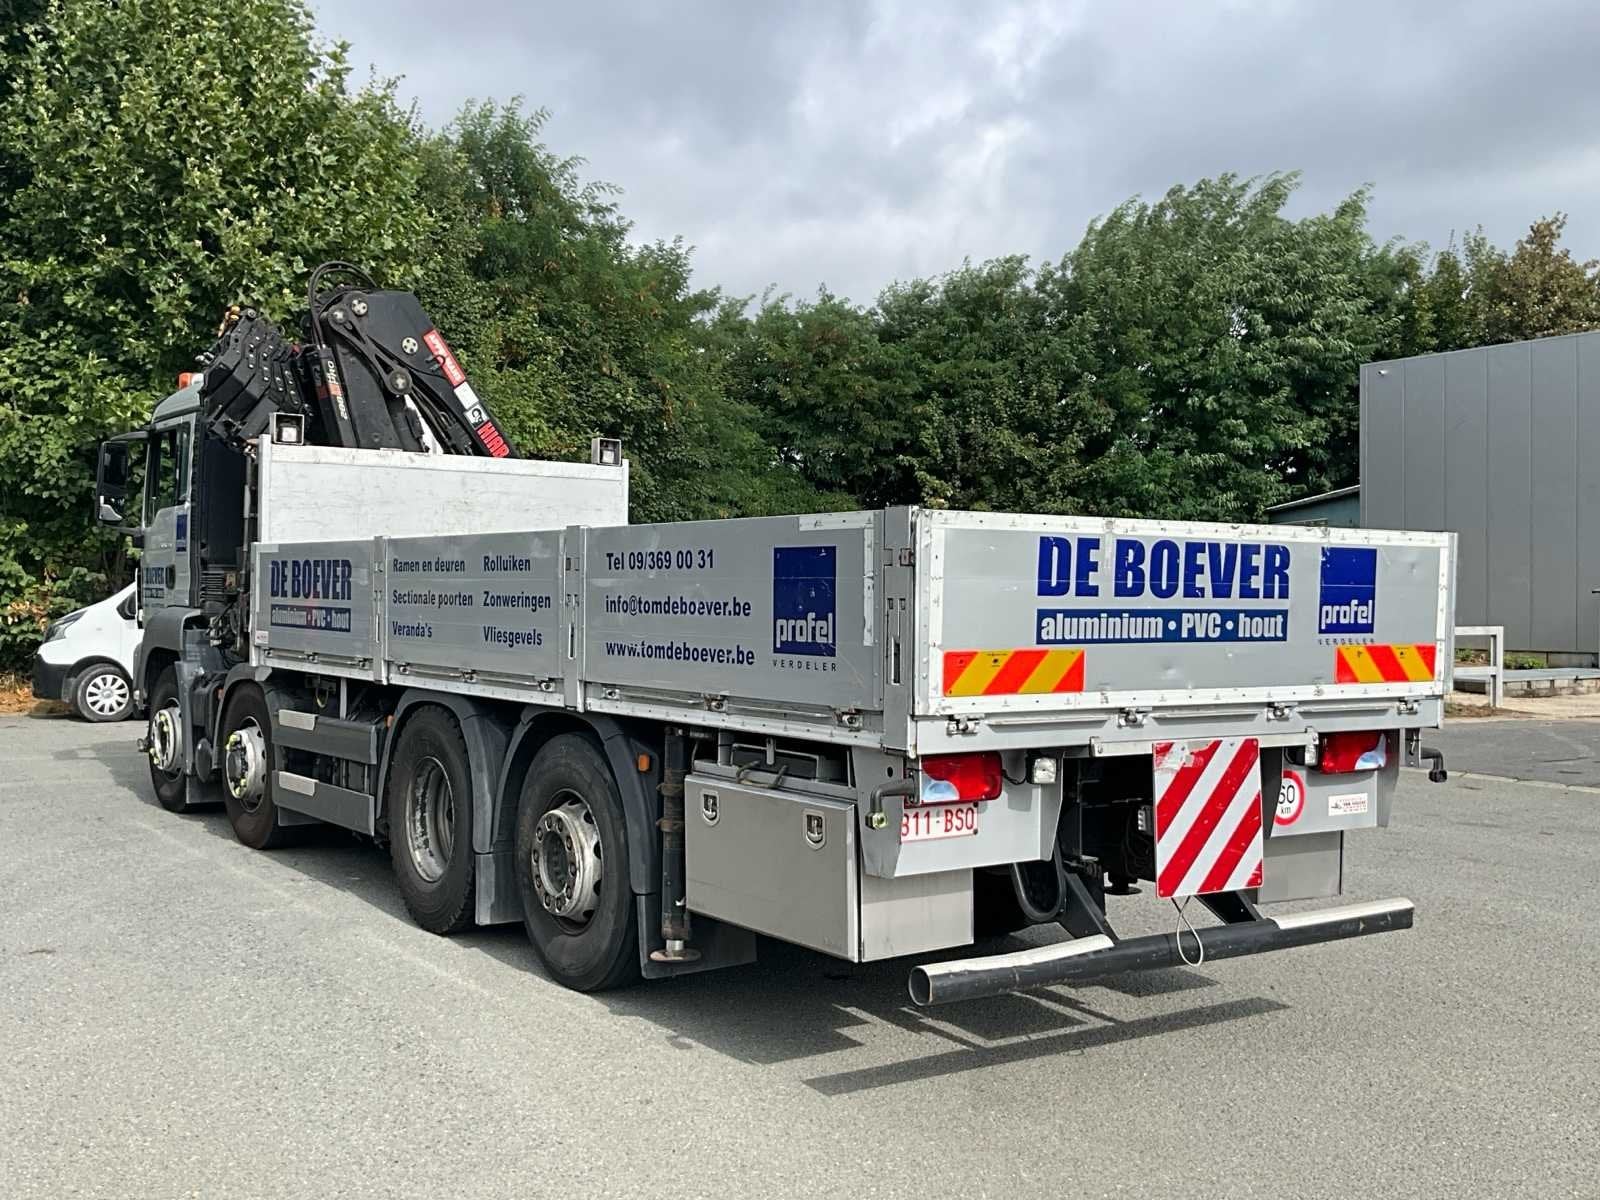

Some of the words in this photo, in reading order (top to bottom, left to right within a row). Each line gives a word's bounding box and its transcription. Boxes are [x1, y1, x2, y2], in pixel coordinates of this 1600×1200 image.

[393, 559, 420, 573] Ramen
[422, 560, 433, 573] en
[434, 557, 466, 573] deuren
[483, 555, 531, 572] Rolluiken
[606, 552, 625, 570] Tel
[628, 550, 672, 570] 09/369
[676, 550, 693, 569] 00
[698, 549, 714, 569] 31
[1037, 536, 1101, 597] DE
[1113, 538, 1291, 600] BOEVER
[271, 560, 288, 598] DE
[291, 559, 352, 601] BOEVER
[393, 589, 436, 605] Sectionale
[438, 591, 473, 609] poorten
[483, 590, 551, 612] Zonweringen
[605, 595, 752, 617] info@tomdeboever.be
[1320, 599, 1374, 630] profel
[392, 620, 433, 638] Veranda's
[483, 625, 543, 648] Vliesgevels
[775, 611, 834, 649] profel
[1041, 612, 1164, 640] aluminium
[1181, 612, 1222, 639] PVC
[1238, 612, 1284, 638] hout
[605, 641, 755, 665] www.tomdeboever.be
[1317, 638, 1375, 646] VERDELER
[772, 658, 837, 672] VERDELER
